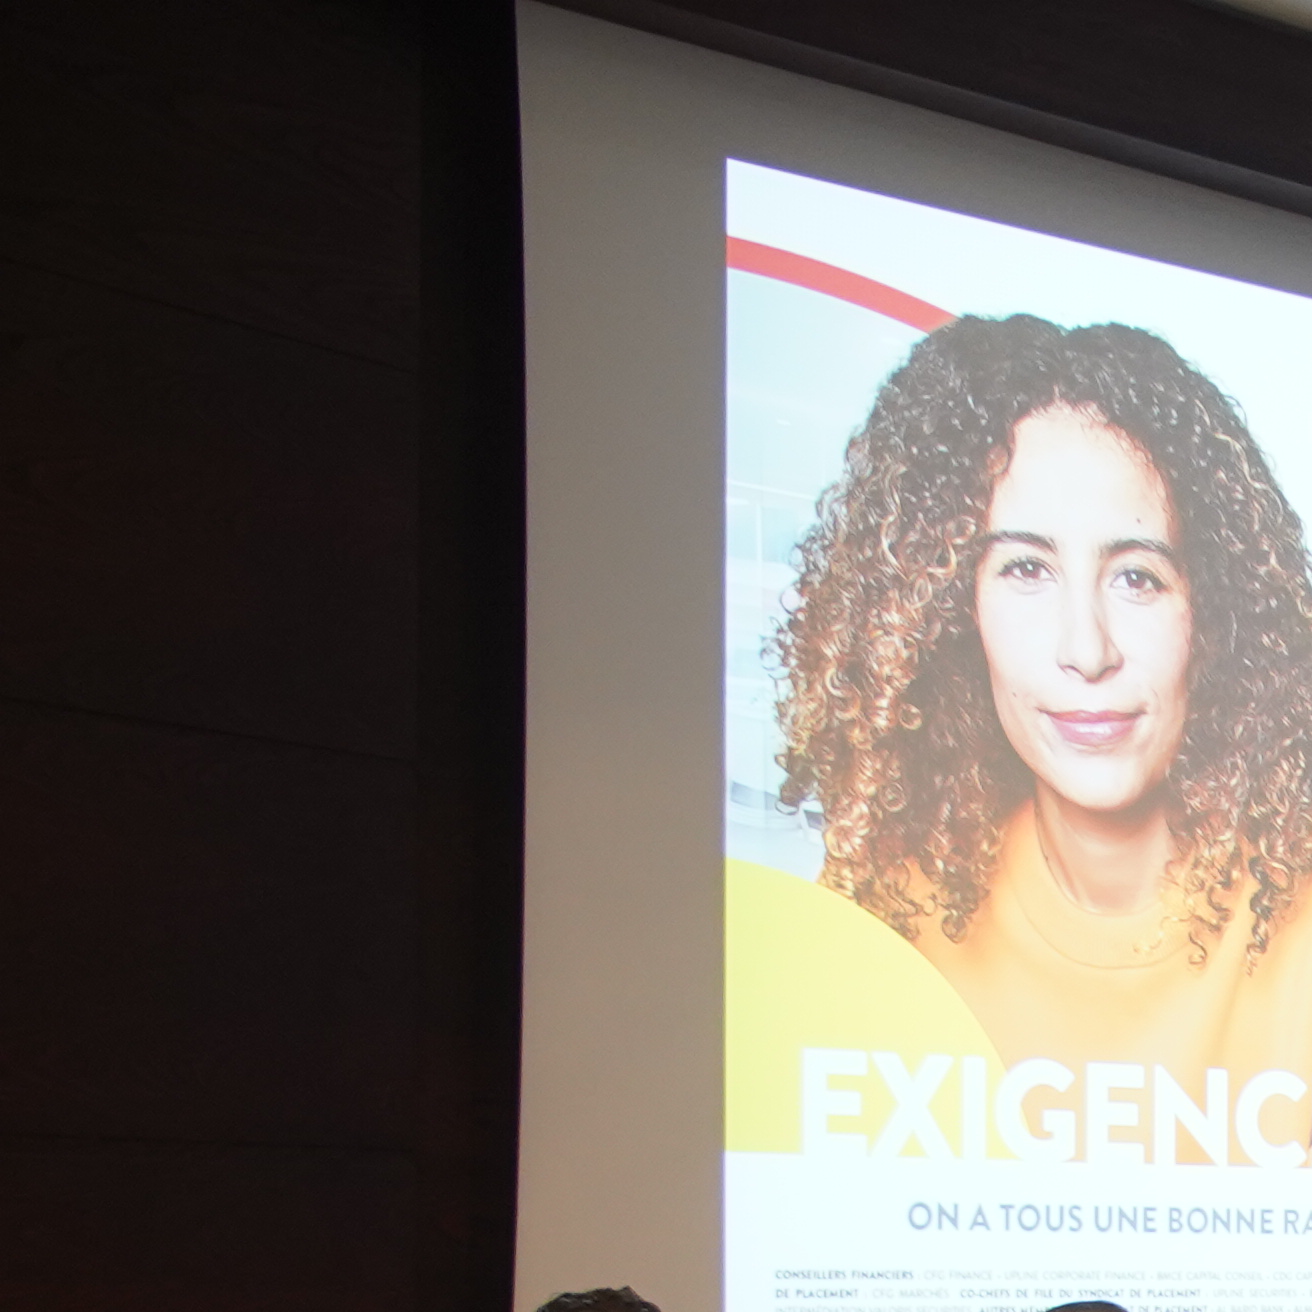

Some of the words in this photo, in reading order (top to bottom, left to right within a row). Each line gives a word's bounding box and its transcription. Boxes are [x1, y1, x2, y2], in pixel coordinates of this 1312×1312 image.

[908, 1202, 959, 1231] ON
[970, 1204, 991, 1231] A
[1000, 1204, 1083, 1233] TOUS
[1095, 1207, 1158, 1233] UNE
[1169, 1208, 1274, 1235] BONNE
[775, 1270, 846, 1279] CONSEILLERS
[851, 1270, 914, 1279] FINANCIERS
[775, 1289, 789, 1298] DE
[796, 1289, 859, 1298] PLACEMENT
